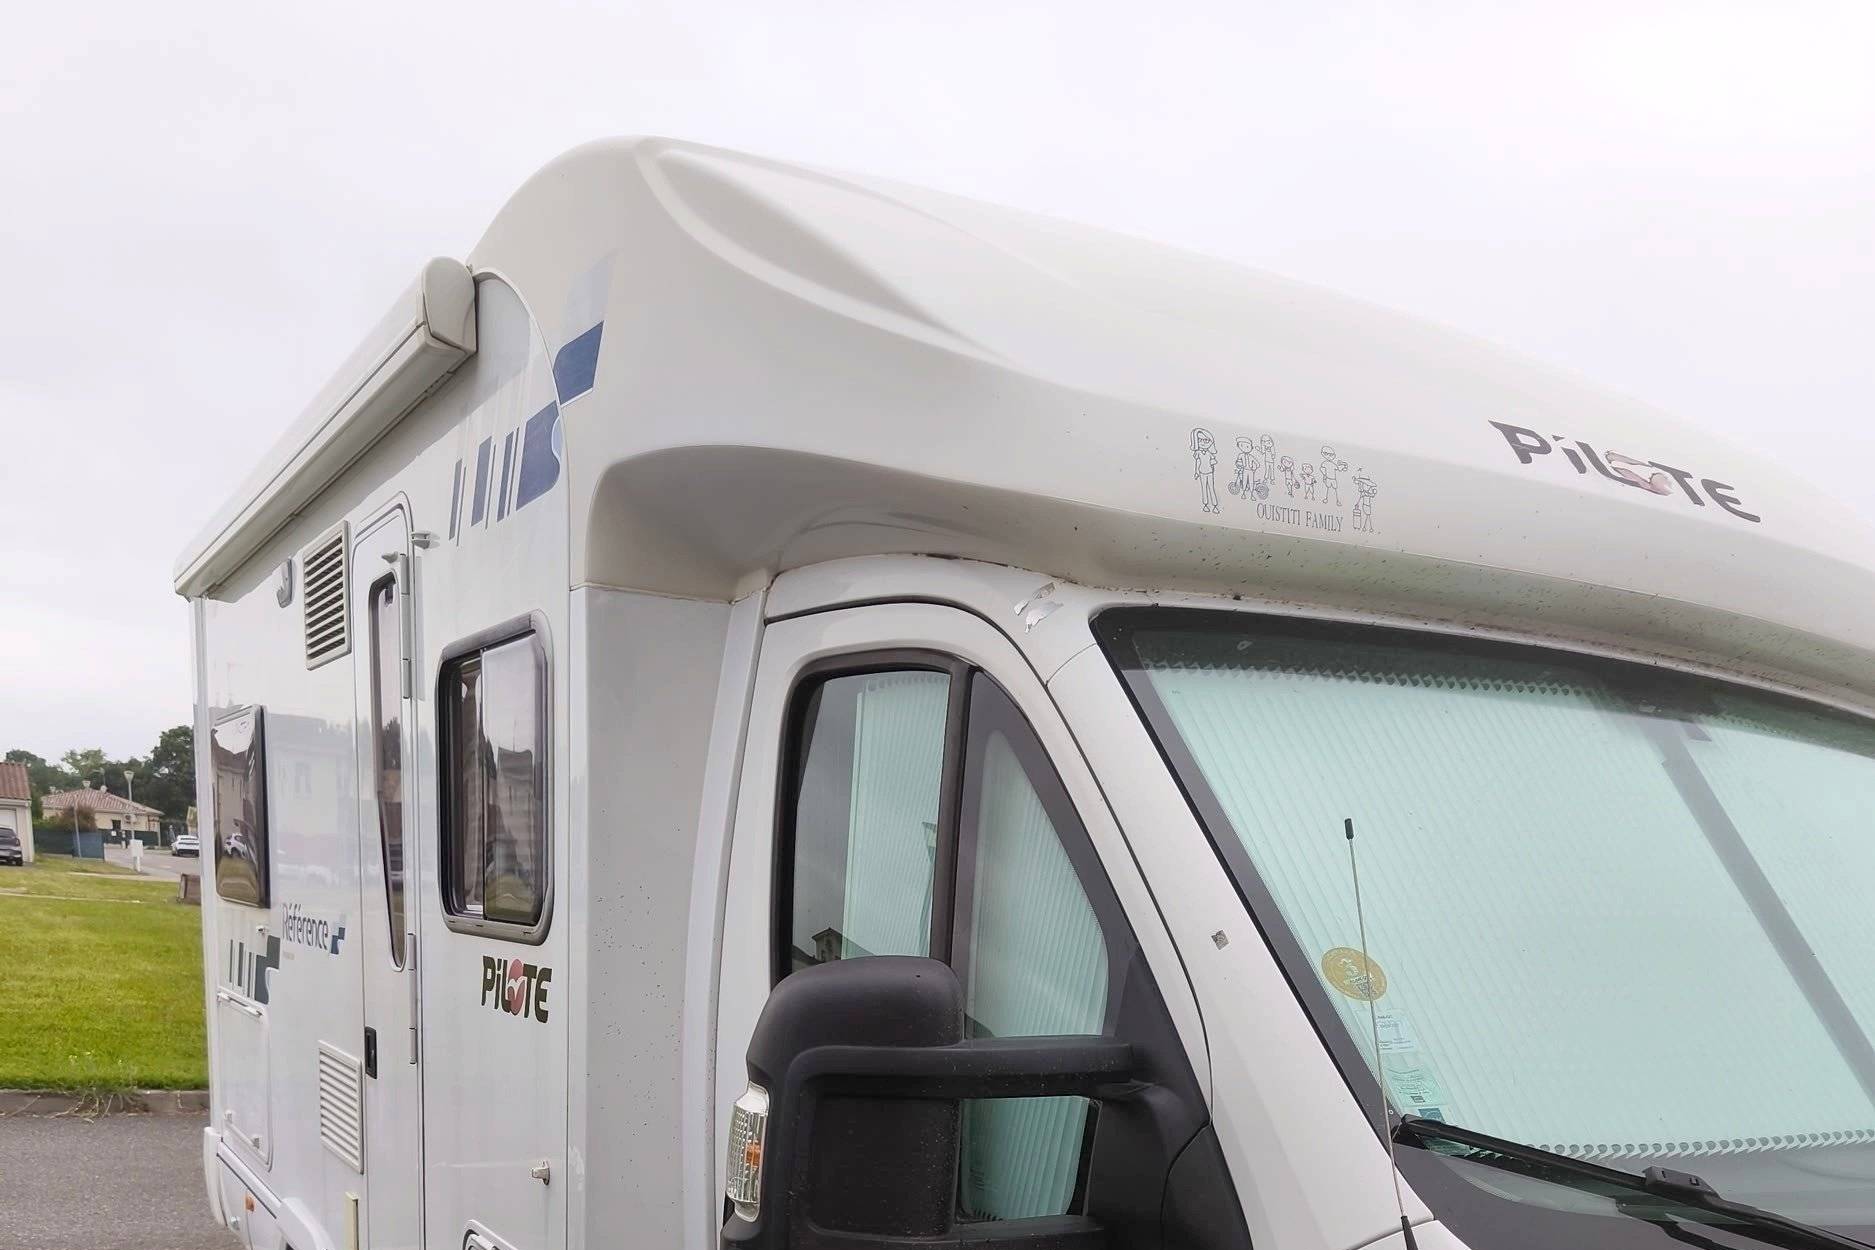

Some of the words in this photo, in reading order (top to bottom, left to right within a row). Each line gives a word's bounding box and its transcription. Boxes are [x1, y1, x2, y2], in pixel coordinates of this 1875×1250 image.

[1256, 502, 1301, 526] OUISTITI
[1305, 510, 1344, 532] FAMILY
[282, 903, 329, 950] Référence
